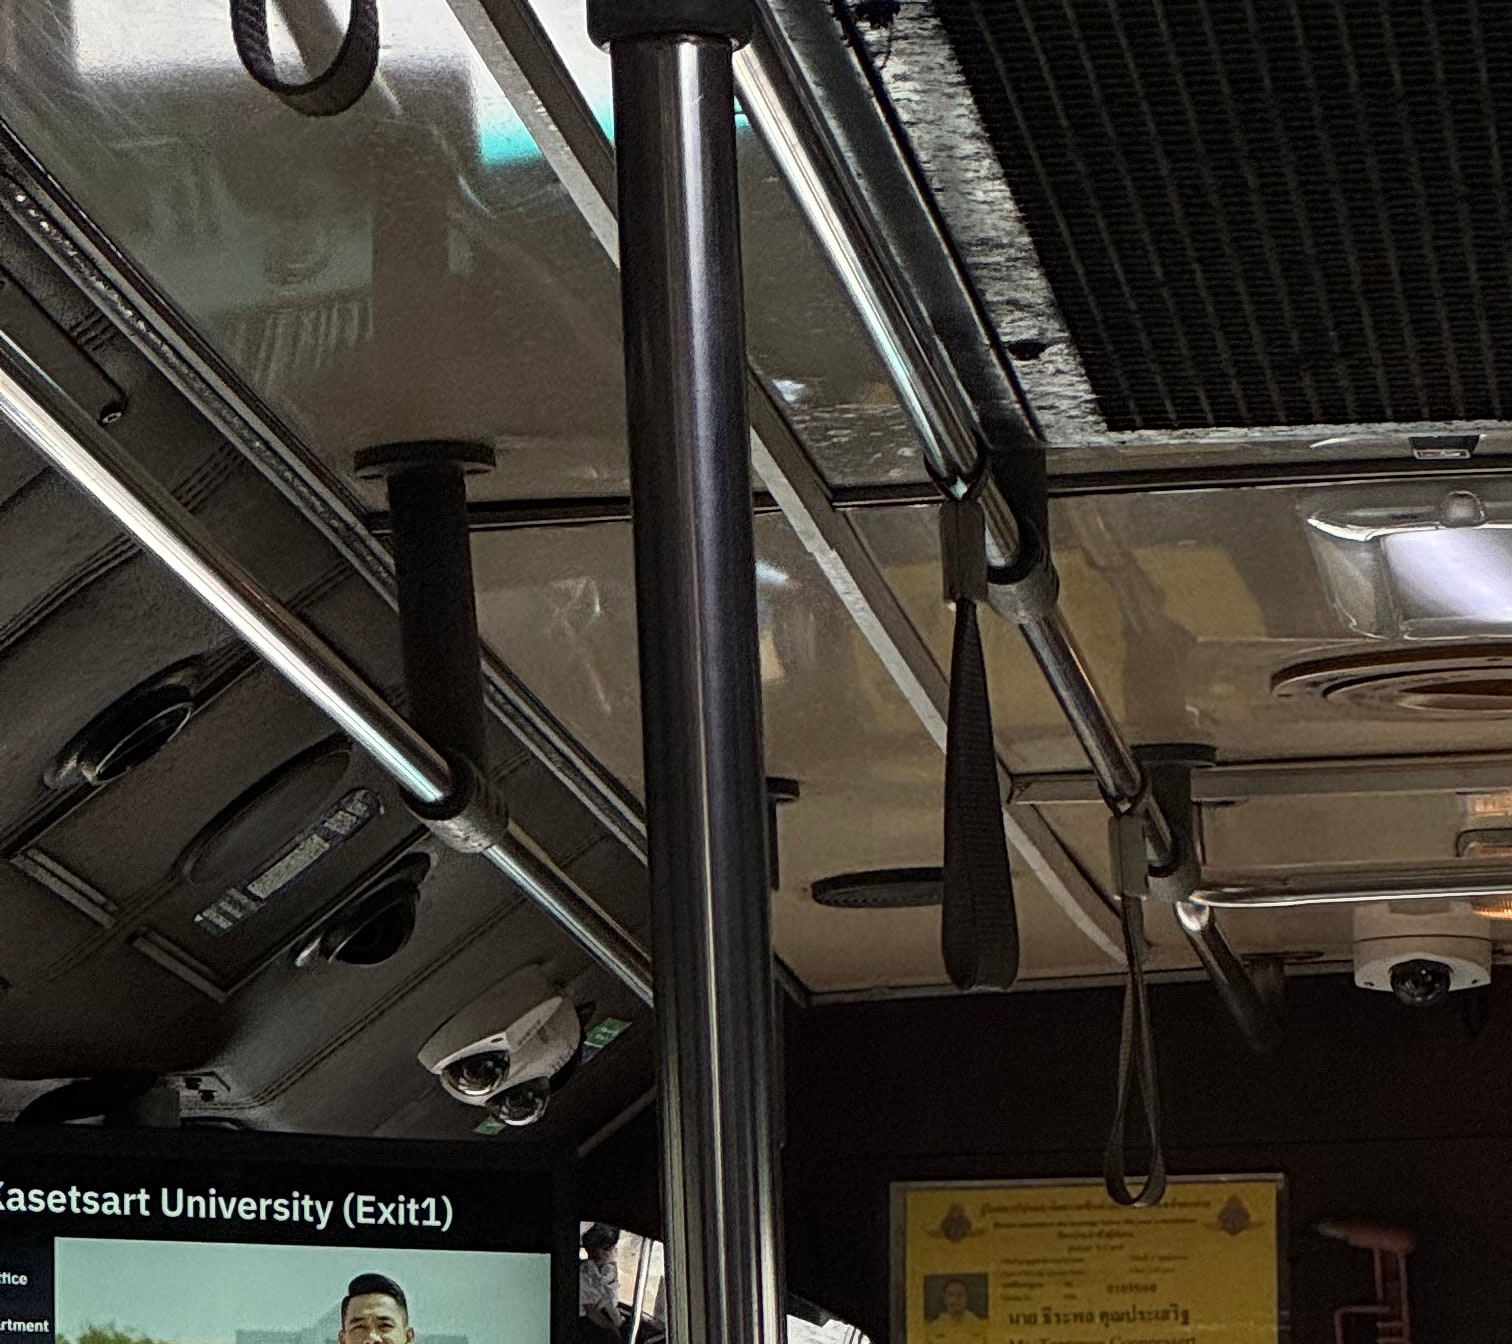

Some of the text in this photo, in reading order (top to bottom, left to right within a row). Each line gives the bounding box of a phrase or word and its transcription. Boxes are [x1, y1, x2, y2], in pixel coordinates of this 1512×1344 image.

[0, 1181, 454, 1233] asetsart University (Exit1)
[0, 1318, 50, 1333] rtment
[1008, 1311, 1038, 1326] นาย
